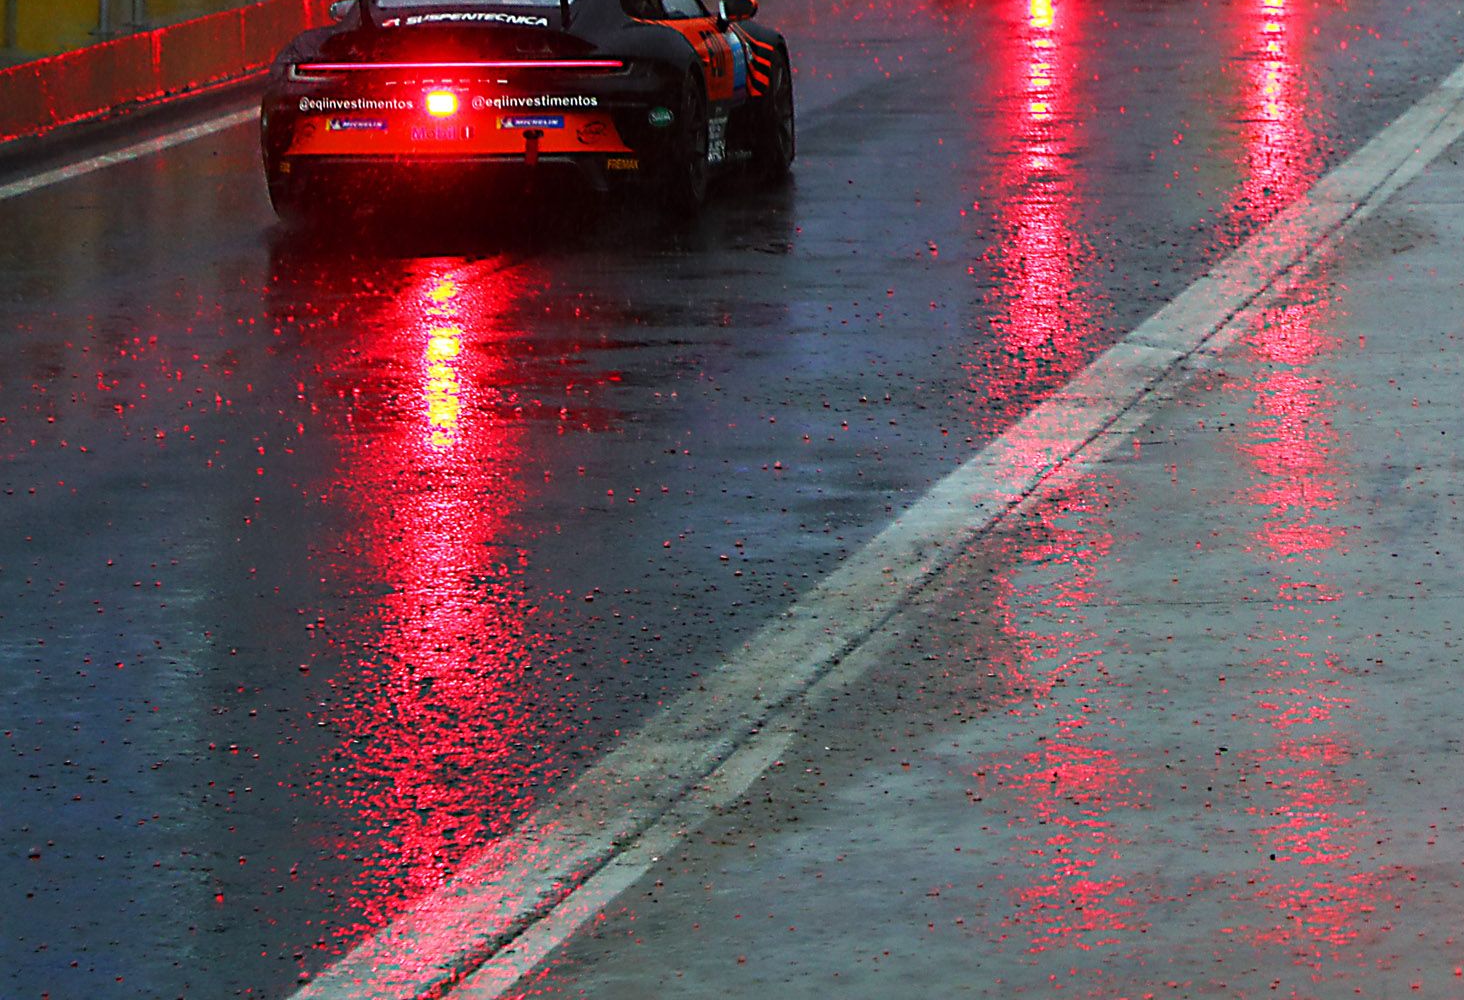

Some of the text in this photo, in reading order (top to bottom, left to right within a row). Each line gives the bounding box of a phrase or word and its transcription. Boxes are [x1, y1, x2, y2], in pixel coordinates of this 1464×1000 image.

[405, 12, 549, 27] SUSPENTECNICA
[299, 97, 415, 112] @eqiinvestimentos
[472, 94, 599, 111] @eqiinvestimentos
